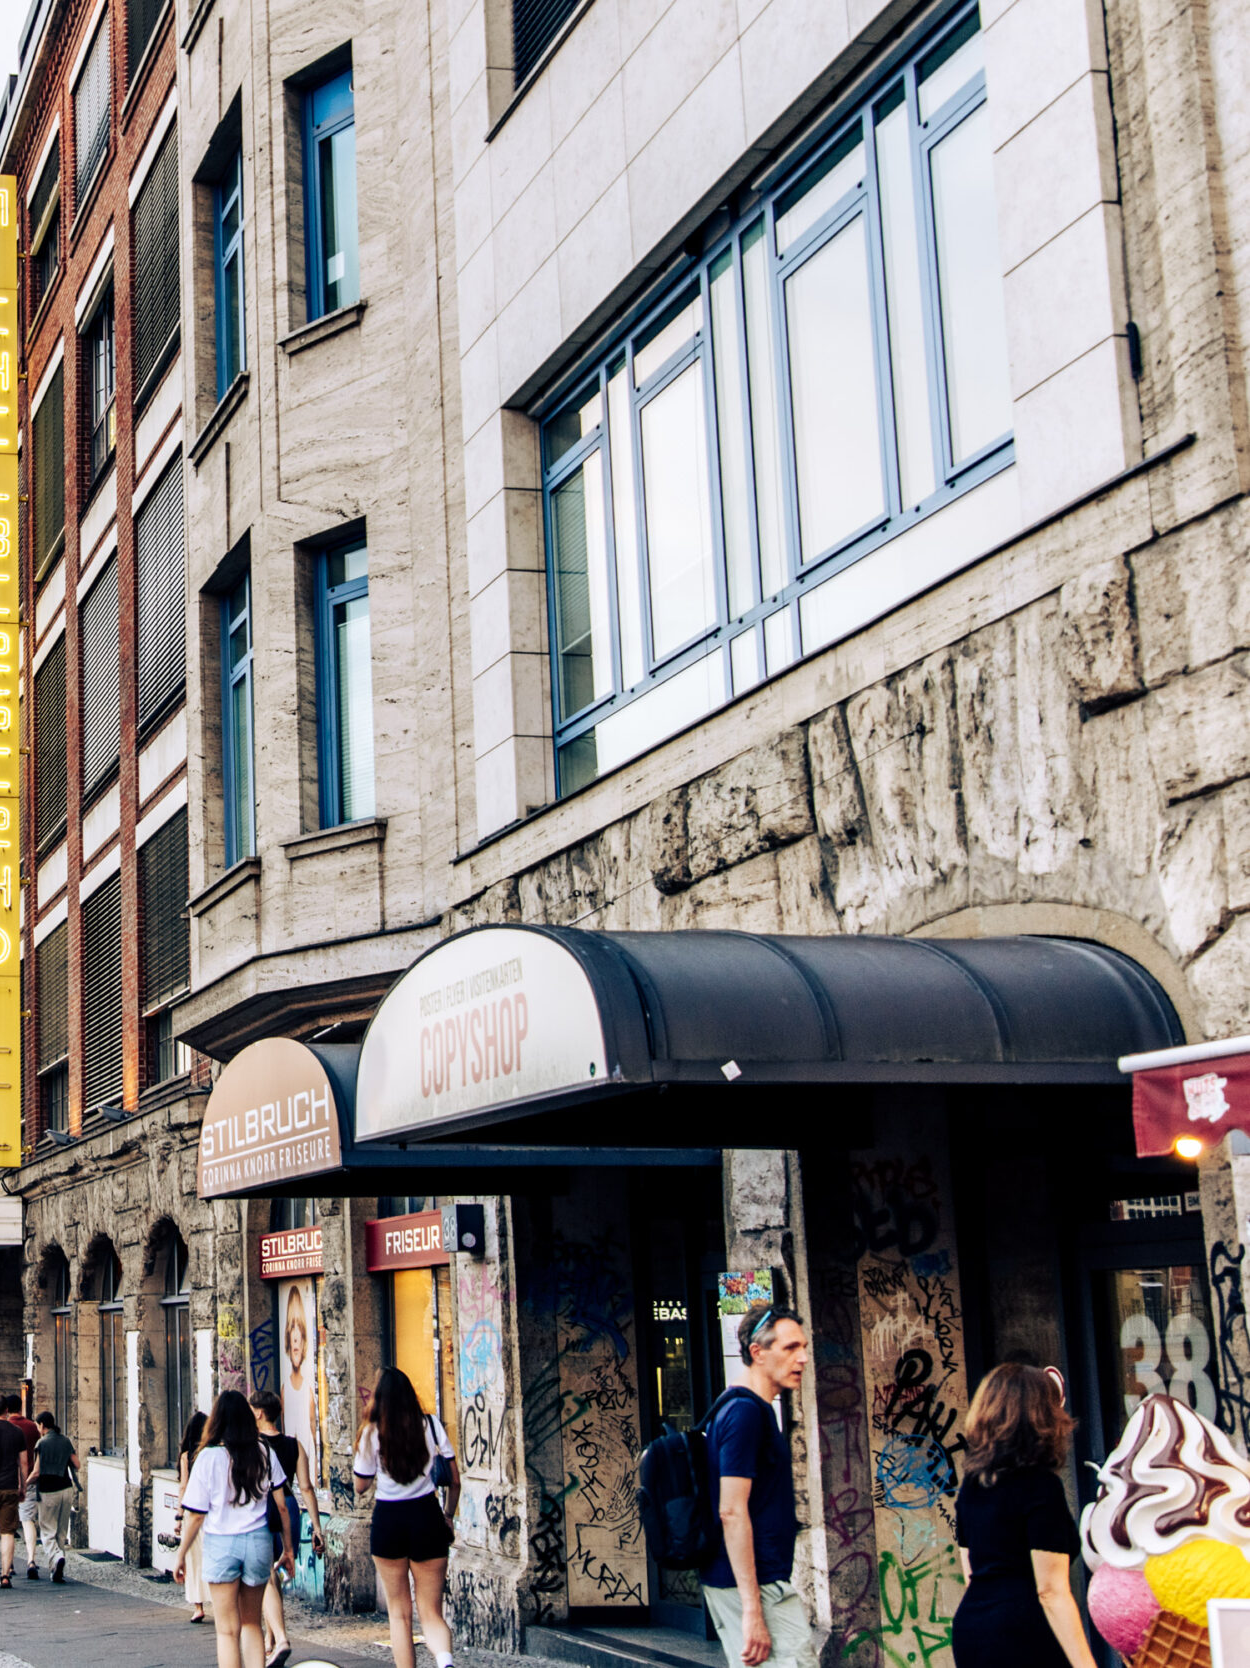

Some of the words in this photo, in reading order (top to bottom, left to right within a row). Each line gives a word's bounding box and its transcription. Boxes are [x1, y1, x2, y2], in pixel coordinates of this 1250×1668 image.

[420, 992, 529, 1099] COPYSHOP
[201, 1083, 330, 1158] STILBRUCH
[202, 1161, 242, 1189] CORINNA
[244, 1151, 276, 1179] KNORR
[279, 1136, 331, 1169] FRISEURE
[262, 1260, 286, 1274] CORINNA
[287, 1257, 305, 1270] KNORR
[385, 1225, 441, 1256] FRISEUR
[1120, 1313, 1217, 1425] 38
